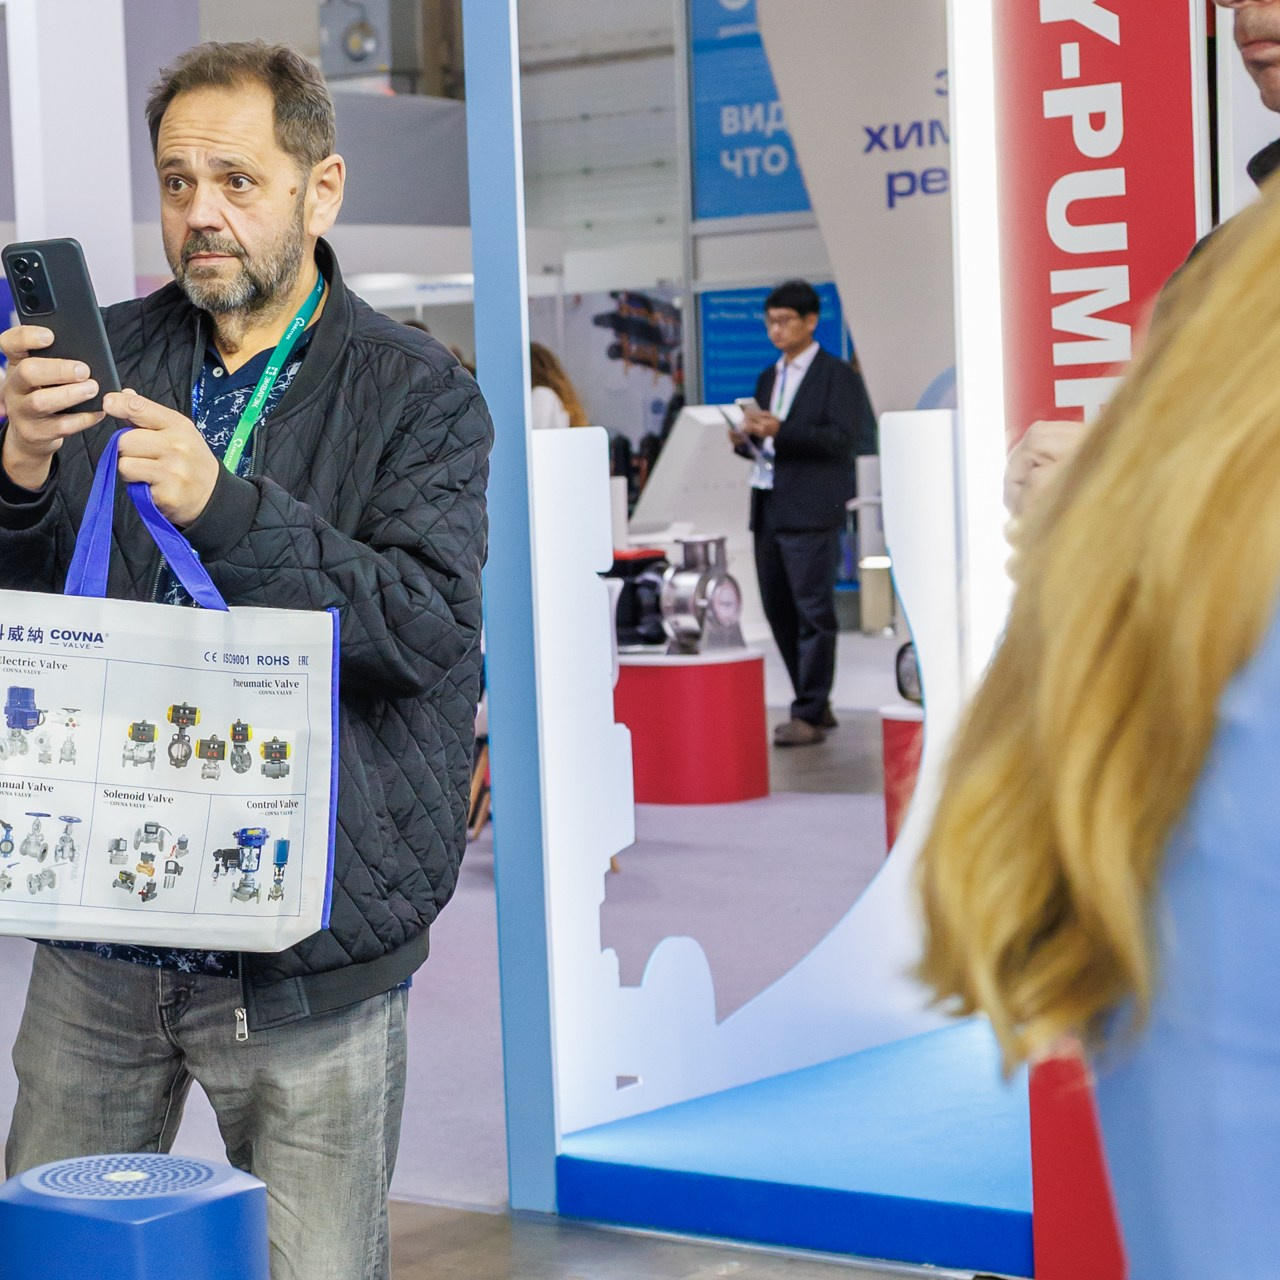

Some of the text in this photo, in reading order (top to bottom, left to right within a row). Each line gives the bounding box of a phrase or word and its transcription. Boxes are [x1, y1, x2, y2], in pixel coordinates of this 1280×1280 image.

[720, 144, 789, 178] ЧТО
[50, 629, 104, 643] COVNA
[62, 642, 91, 650] VALVE
[39, 659, 68, 671] Valve
[223, 653, 250, 665] ISO9001
[257, 655, 290, 666] ROHS
[233, 678, 300, 689] Pneumatic Valve
[27, 781, 54, 793] Valve
[103, 789, 174, 804] Solenoid Valve
[246, 800, 299, 810] Control Valve
